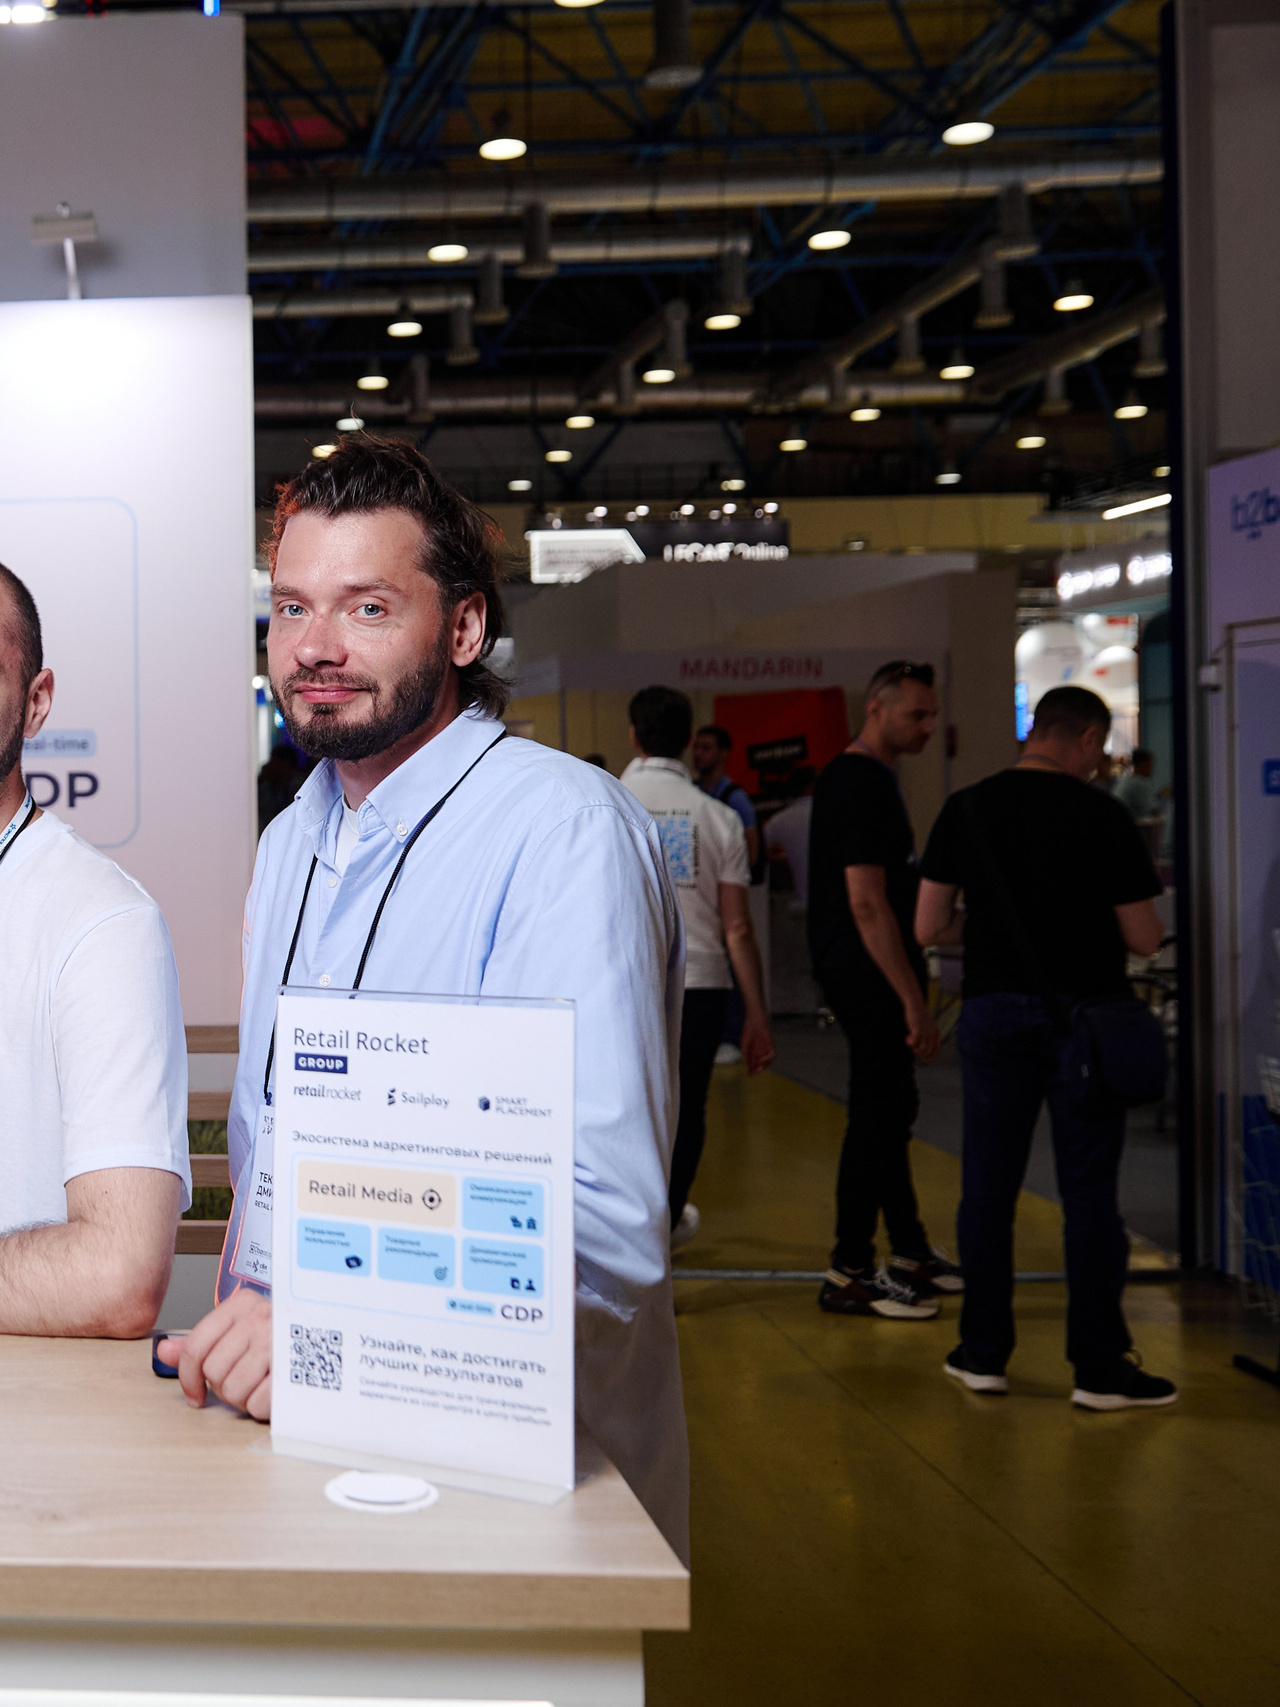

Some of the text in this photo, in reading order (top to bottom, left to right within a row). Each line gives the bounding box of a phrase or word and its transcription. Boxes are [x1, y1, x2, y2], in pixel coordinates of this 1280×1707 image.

[680, 656, 823, 681] MANDARIN
[24, 736, 88, 751] eal-time
[25, 773, 99, 808] DP
[294, 1028, 429, 1054] Retail Rocket
[298, 1056, 344, 1071] GROUP
[293, 1084, 361, 1101] retailrocket
[401, 1091, 450, 1111] Sailplay
[495, 1096, 528, 1106] SMART
[495, 1106, 552, 1118] PLACEMENT
[292, 1130, 553, 1166] Экосистема маркетинговых решений
[308, 1179, 413, 1205] Retail Media
[501, 1304, 543, 1322] CDP
[359, 1334, 546, 1374] Узнайте, как достигать
[359, 1353, 523, 1388] лучших результатов
